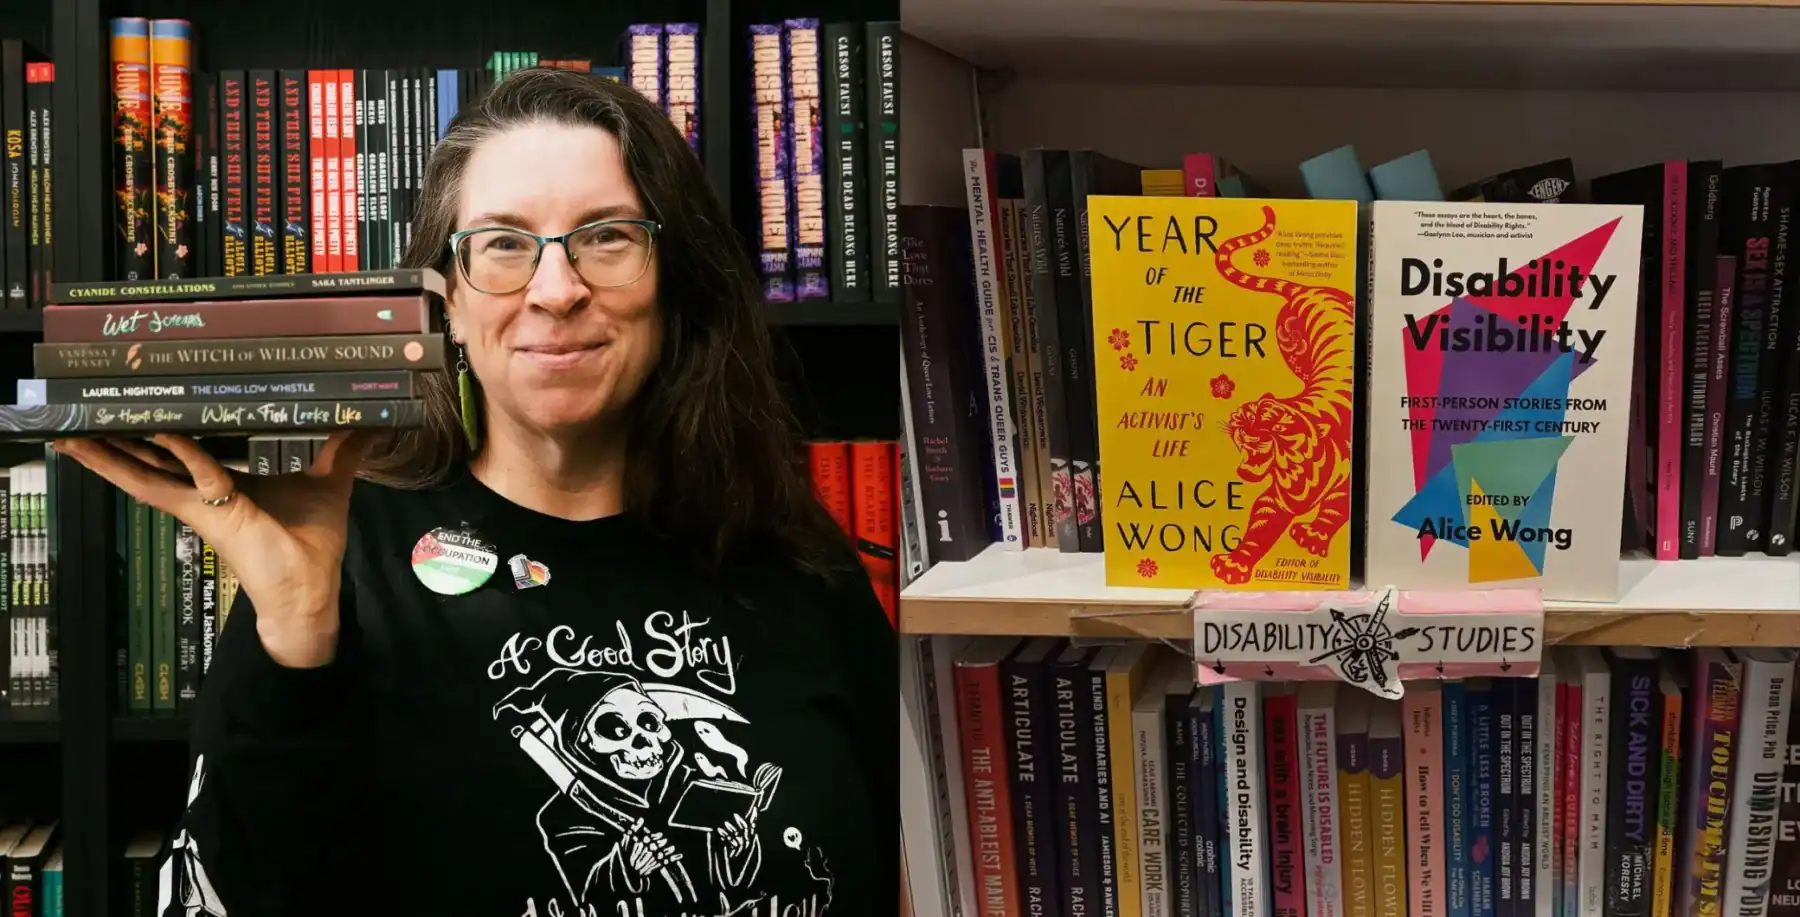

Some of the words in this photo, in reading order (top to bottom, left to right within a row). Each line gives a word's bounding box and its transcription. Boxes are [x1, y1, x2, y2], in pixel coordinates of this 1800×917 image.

[669, 34, 696, 103] HOUSE
[753, 34, 783, 103] HOUSE
[790, 28, 820, 99] HOUSE
[837, 36, 850, 83] CARSON
[116, 63, 141, 110] JUNIE
[158, 65, 182, 111] JUNIE
[225, 79, 241, 107] AND
[839, 84, 851, 116] FAUST
[355, 100, 364, 125] HEXIS
[7, 129, 22, 158] KOSA
[226, 110, 241, 150] THEN
[841, 140, 852, 153] IF
[227, 154, 242, 184] SHE
[842, 156, 854, 177] THE
[797, 174, 824, 244] WOMEN
[842, 179, 855, 210] DEAD
[971, 176, 985, 227] MENTAL
[1704, 174, 1720, 221] Goldberg
[760, 178, 788, 249] WOMEN
[1474, 222, 1503, 230] Disability
[843, 212, 857, 256] BELONG
[1103, 214, 1219, 255] YEAR
[1467, 231, 1495, 239] musician
[1773, 207, 1790, 276] SHAME-SEX
[235, 240, 245, 274] ALICIA
[977, 229, 991, 278] HEALTH
[1744, 236, 1770, 270] SEX
[69, 288, 116, 298] CYANIDE
[120, 283, 216, 296] CONSTELLATIONS
[311, 278, 335, 288] SARA
[338, 276, 395, 287] TANTLINGER
[845, 260, 857, 289] HERE
[1145, 266, 1168, 286] OF
[1400, 257, 1618, 310] Disability
[982, 280, 995, 316] GUIDE
[1173, 285, 1206, 304] THE
[1720, 287, 1731, 304] The
[103, 310, 149, 336] Wet
[1717, 307, 1730, 351] Screwball
[1766, 278, 1783, 350] ATTRACTION
[148, 353, 175, 364] THE
[177, 348, 234, 363] WITCH
[238, 351, 255, 362] OF
[259, 347, 329, 361] WILLOW
[335, 345, 394, 360] SOUND
[988, 335, 998, 353] CIS
[1137, 320, 1267, 359] TIGER
[1404, 313, 1607, 365] Visibility
[1715, 352, 1726, 380] Asses
[82, 387, 121, 397] LAUREL
[123, 385, 185, 396] HIGHTOWER
[191, 385, 211, 395] THE
[213, 384, 242, 394] LONG
[244, 383, 268, 394] LOW
[270, 382, 316, 393] WHISTLE
[990, 364, 1002, 402] TRANS
[1140, 377, 1168, 397] AN
[201, 404, 246, 425] What
[257, 402, 289, 423] Fish
[293, 402, 330, 425] Looks
[335, 402, 362, 425] Like
[1400, 397, 1499, 410] FIRST-PERSON
[1503, 398, 1562, 411] STORIES
[1565, 399, 1607, 412] FROM
[995, 405, 1007, 442] QUEER
[1116, 411, 1205, 431] ACTIVIST'S
[1401, 419, 1427, 431] THE
[1431, 419, 1531, 433] TWENTY-FIRST
[1534, 420, 1601, 434] CENTURY
[1710, 412, 1722, 447] Christian
[999, 445, 1011, 474] GUYS
[1152, 439, 1191, 458] LIFE
[1708, 449, 1719, 476] Maurel
[1116, 479, 1245, 510] ALICE
[1466, 494, 1510, 506] EDITED
[1512, 495, 1530, 507] BY
[438, 532, 460, 544] END
[461, 536, 482, 547] THE
[1116, 521, 1243, 553] WONG
[1416, 517, 1483, 542] Alice
[1490, 518, 1573, 550] Wong
[1687, 520, 1695, 544] SUNY
[422, 545, 490, 566] OCCUPATION
[1275, 557, 1307, 568] EDITOR
[1309, 558, 1320, 568] OF
[182, 549, 194, 625] POCKETBOOK
[1255, 569, 1299, 581] DISABILITY
[1301, 571, 1341, 583] VISIBILITY
[203, 579, 216, 610] Mark
[546, 620, 645, 671] Good
[644, 610, 736, 695] Story
[1203, 621, 1336, 655] DISABILITY
[1418, 625, 1536, 653] STUDIES
[1091, 676, 1103, 711] BLIND
[1629, 675, 1651, 727] SICK
[1767, 677, 1785, 707] Devon
[1232, 697, 1250, 755] Design
[1314, 713, 1327, 738] THE
[1499, 714, 1512, 729] OUT
[1594, 696, 1605, 724] THE
[1763, 709, 1782, 739] Price,
[1011, 674, 1035, 782] ARTICULATE
[1056, 677, 1079, 784] ARTICULATE
[1500, 730, 1512, 738] IN
[971, 747, 992, 774] THE
[1094, 713, 1108, 785] VISIONARIES
[1500, 739, 1512, 755] THE
[1593, 733, 1603, 779] RIGHT
[1627, 731, 1647, 776] AND
[1761, 740, 1776, 759] PhD
[1236, 759, 1251, 790] and
[1316, 740, 1330, 790] FUTURE
[1418, 765, 1430, 791] How
[1500, 756, 1512, 795] SPECTRUM
[1706, 730, 1733, 815] TOUCH
[1098, 787, 1109, 808] AND
[1318, 792, 1331, 801] IS
[1419, 795, 1429, 807] to
[1451, 774, 1462, 802] DON'T
[1591, 789, 1601, 805] TO
[975, 778, 1001, 870] ANTI-ABLEIST
[1099, 812, 1110, 824] AI
[1348, 783, 1363, 851] HIDDEN
[1380, 788, 1396, 857] HIDDEN
[1419, 810, 1431, 831] Tell
[1452, 803, 1462, 816] DO
[1624, 780, 1646, 841] DIRTY
[1743, 771, 1780, 879] UNMASKING
[1141, 808, 1160, 846] CARE
[1236, 793, 1253, 871] Disability
[1319, 806, 1333, 864] DISABLED
[1452, 819, 1463, 862] DISABILITY
[1590, 813, 1600, 850] MAIM
[1101, 835, 1113, 876] JAMIESON
[1195, 835, 1206, 868] crohnic
[1206, 840, 1217, 874] crohnic
[1420, 834, 1432, 866] When
[1143, 852, 1163, 892] WORK
[1421, 870, 1432, 886] We
[1619, 853, 1632, 902] KORESKY
[1632, 854, 1644, 900] MICHAEL
[1422, 889, 1435, 912] Will
